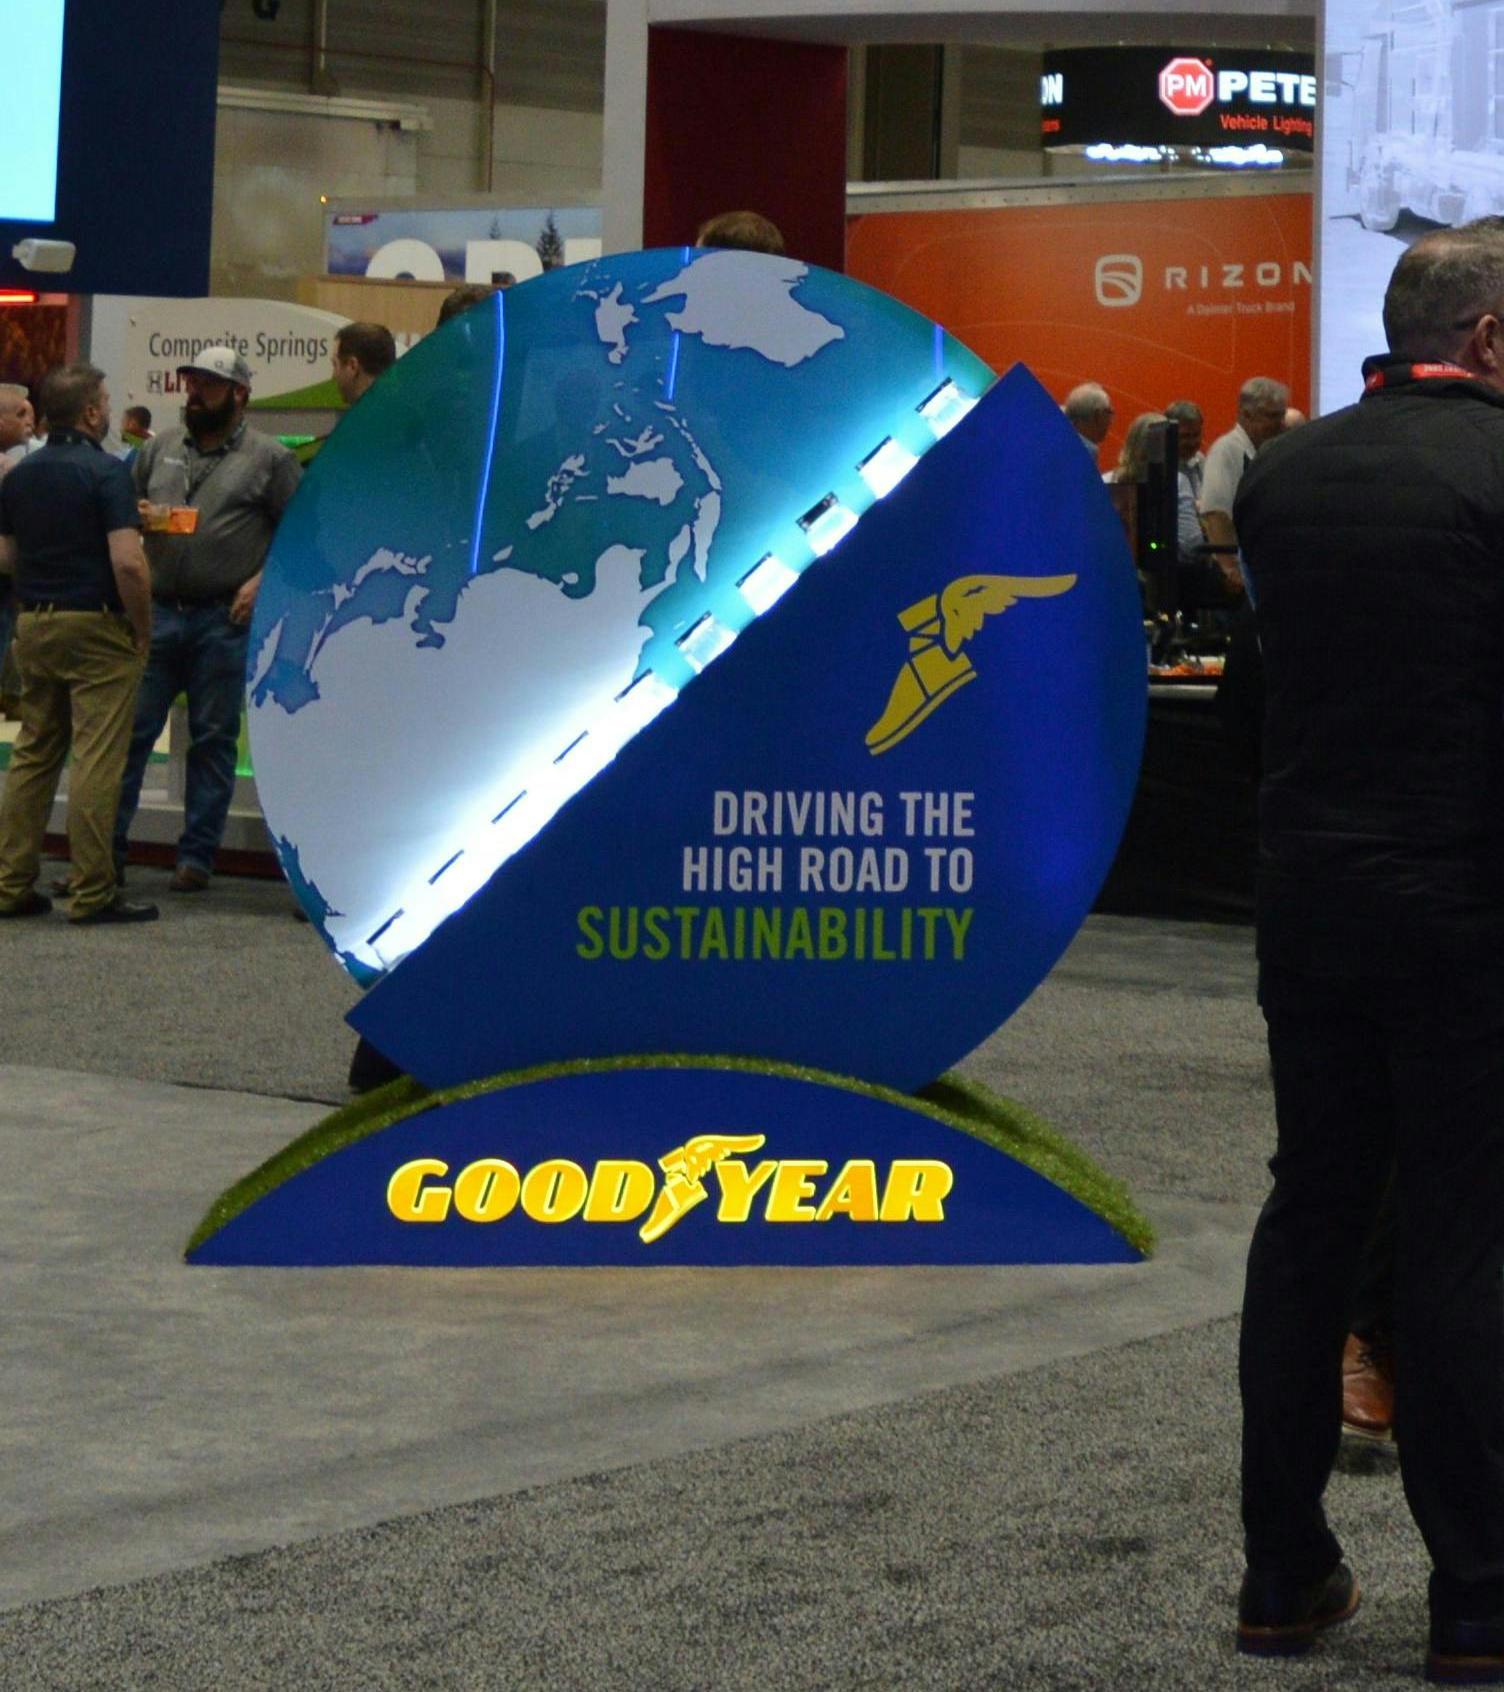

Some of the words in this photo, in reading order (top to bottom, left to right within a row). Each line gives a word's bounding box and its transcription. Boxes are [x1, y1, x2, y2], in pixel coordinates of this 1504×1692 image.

[1167, 74, 1207, 98] PM
[1218, 69, 1317, 107] PETE
[1219, 114, 1268, 131] Vehicle
[1164, 260, 1313, 290] RIZON
[148, 331, 249, 364] Composite
[255, 330, 328, 364] Springs
[712, 790, 884, 836] DRIVING
[899, 791, 975, 837] THE
[682, 846, 783, 892] HIGH
[799, 847, 909, 892] ROAD
[924, 847, 974, 893] TO
[575, 905, 974, 961] SUSTAINABILITY
